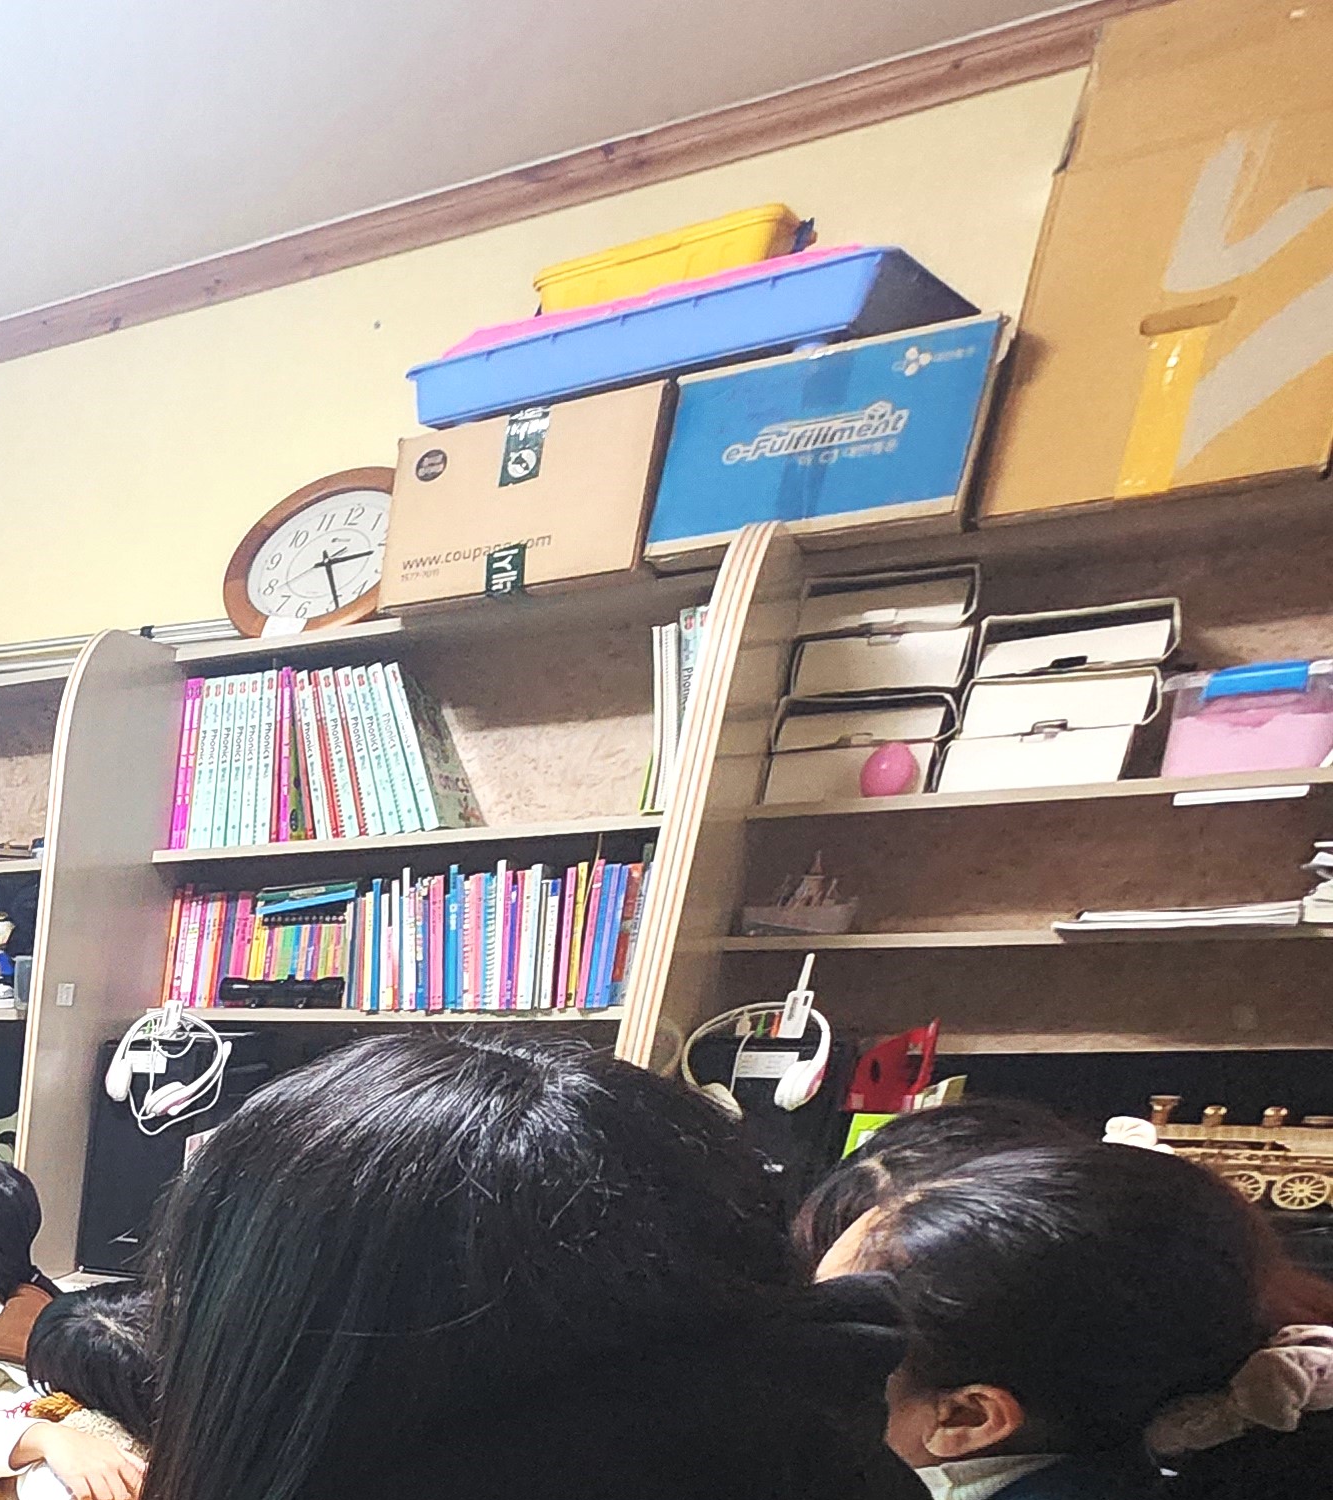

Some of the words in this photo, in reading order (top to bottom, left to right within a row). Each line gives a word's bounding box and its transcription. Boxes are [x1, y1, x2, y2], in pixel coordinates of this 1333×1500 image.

[723, 410, 909, 462] e-Fulfillment
[316, 513, 336, 532] 11
[343, 506, 365, 526] 12
[371, 512, 383, 532] 1
[288, 530, 309, 549] 10
[266, 553, 283, 571] 9
[262, 578, 280, 596] 8
[275, 595, 291, 613] 7
[294, 600, 312, 619] 6
[208, 728, 218, 766] Phonics
[221, 727, 231, 764] Phonics
[234, 725, 244, 763] Phonics
[247, 724, 256, 762] Phonics
[263, 722, 272, 760] Phonics
[304, 721, 313, 758] Phonics
[331, 717, 342, 755] Phonics
[351, 715, 364, 753] Phonics
[366, 715, 379, 752] Phonics
